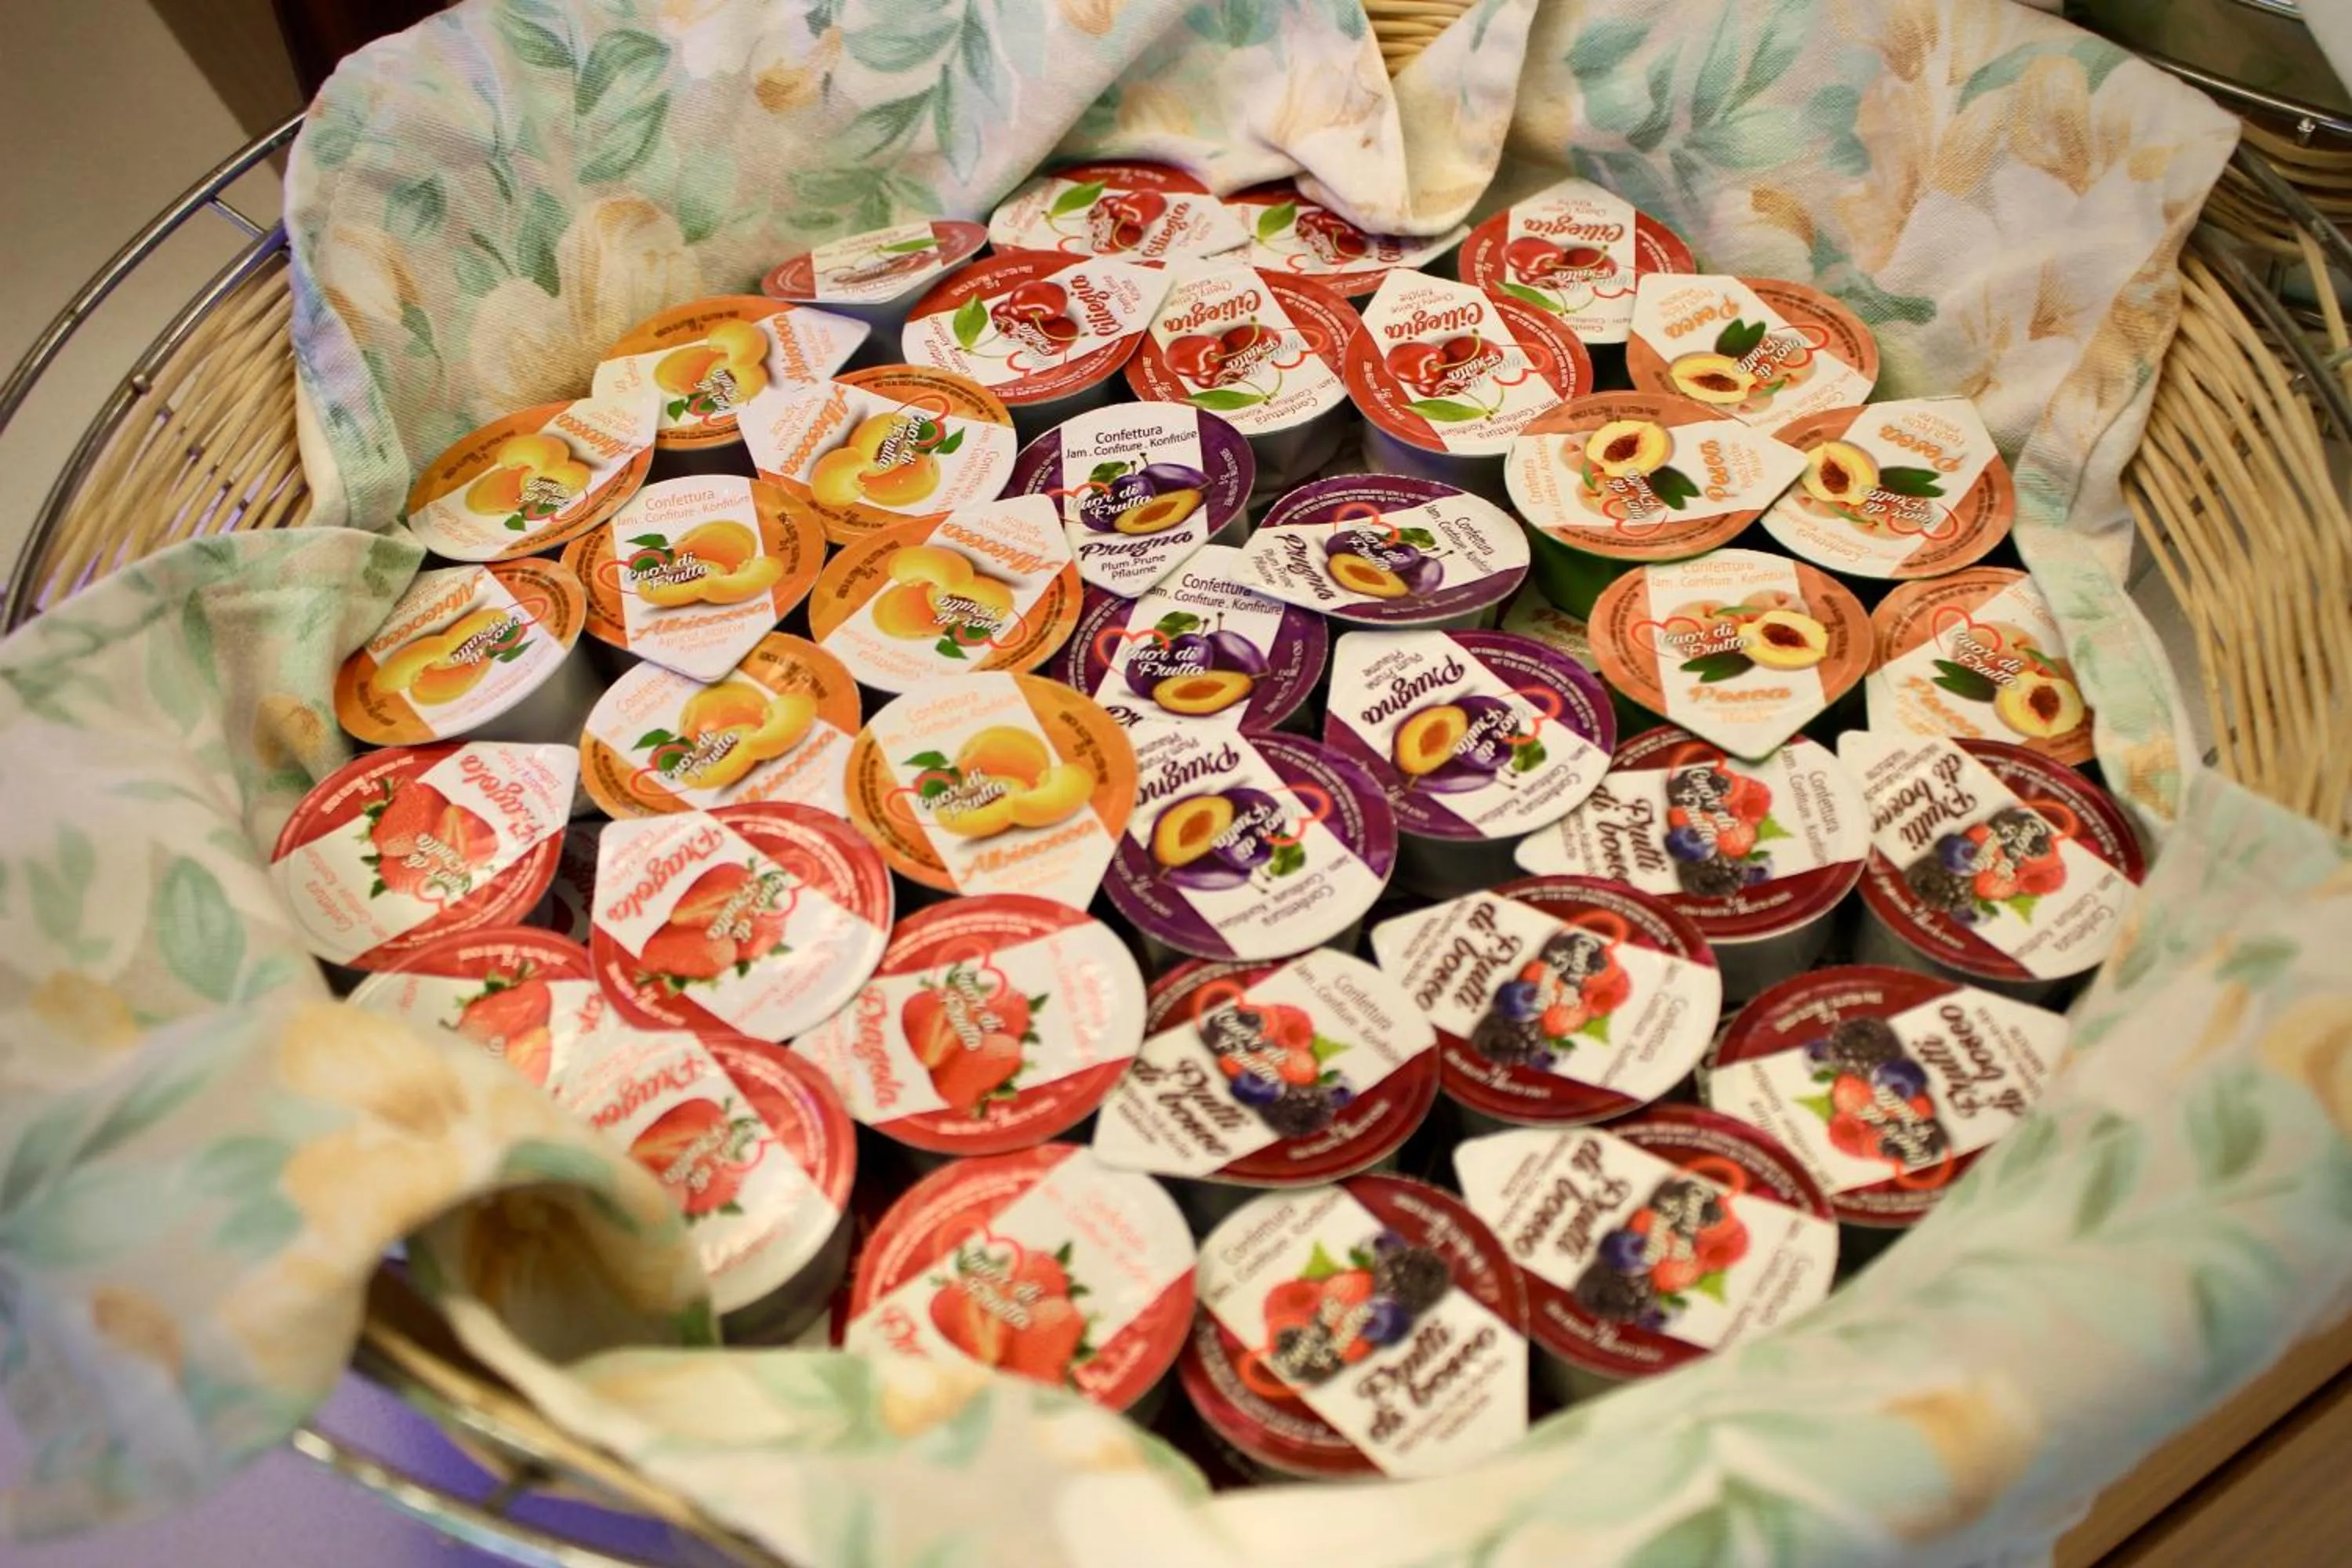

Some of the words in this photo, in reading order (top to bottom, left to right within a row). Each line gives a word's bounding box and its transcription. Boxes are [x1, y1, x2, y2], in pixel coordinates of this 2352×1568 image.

[1524, 216, 1624, 242] Ciliegia
[1070, 276, 1123, 337] Ciliegia
[1163, 290, 1261, 332] Ciliegia
[1384, 303, 1484, 339] Ciliegia
[1664, 295, 1740, 338] Pesca
[780, 384, 848, 475] Albicocca
[1095, 426, 1163, 444] Confettura
[1066, 449, 1087, 458] Jam
[1094, 441, 1142, 456] Confiture
[1878, 425, 1965, 472] Pesca
[1699, 440, 1738, 502] Pesca
[645, 490, 715, 510] Confettura
[1090, 495, 1152, 522] Frutta
[1120, 485, 1139, 499] di
[942, 524, 1064, 575] Albicocca
[1079, 531, 1194, 561] Prugna
[627, 564, 668, 579] Cuor
[677, 552, 696, 567] di
[648, 566, 710, 590] Frutta
[1102, 561, 1129, 571] Plum
[1112, 565, 1157, 580] Pflaume
[1275, 534, 1336, 601] Prugna
[1144, 586, 1167, 597] am
[1174, 590, 1225, 608] Confiture
[1181, 574, 1252, 597] Confettura
[370, 574, 484, 652] Albicocca
[1714, 623, 1735, 638] di
[1175, 647, 1200, 660] di
[1684, 637, 1749, 659] Frutta
[1137, 662, 1206, 677] Frutta
[1361, 655, 1465, 724] Prugna
[968, 768, 987, 786] di
[1932, 753, 1962, 787] di
[1624, 797, 1668, 874] Frutti
[1900, 790, 1977, 851] Frutti
[607, 827, 724, 923] Fragola
[1468, 902, 1496, 937] di
[1415, 937, 1476, 1011] bosco
[1452, 936, 1523, 1013] Frutti
[1940, 1005, 2004, 1081] bosco
[1912, 1034, 1979, 1118] Frutti
[1176, 1060, 1252, 1129] Frutti
[1571, 1139, 1602, 1174] di
[1513, 1179, 1584, 1257] bosco
[1555, 1179, 1632, 1262] Frutti
